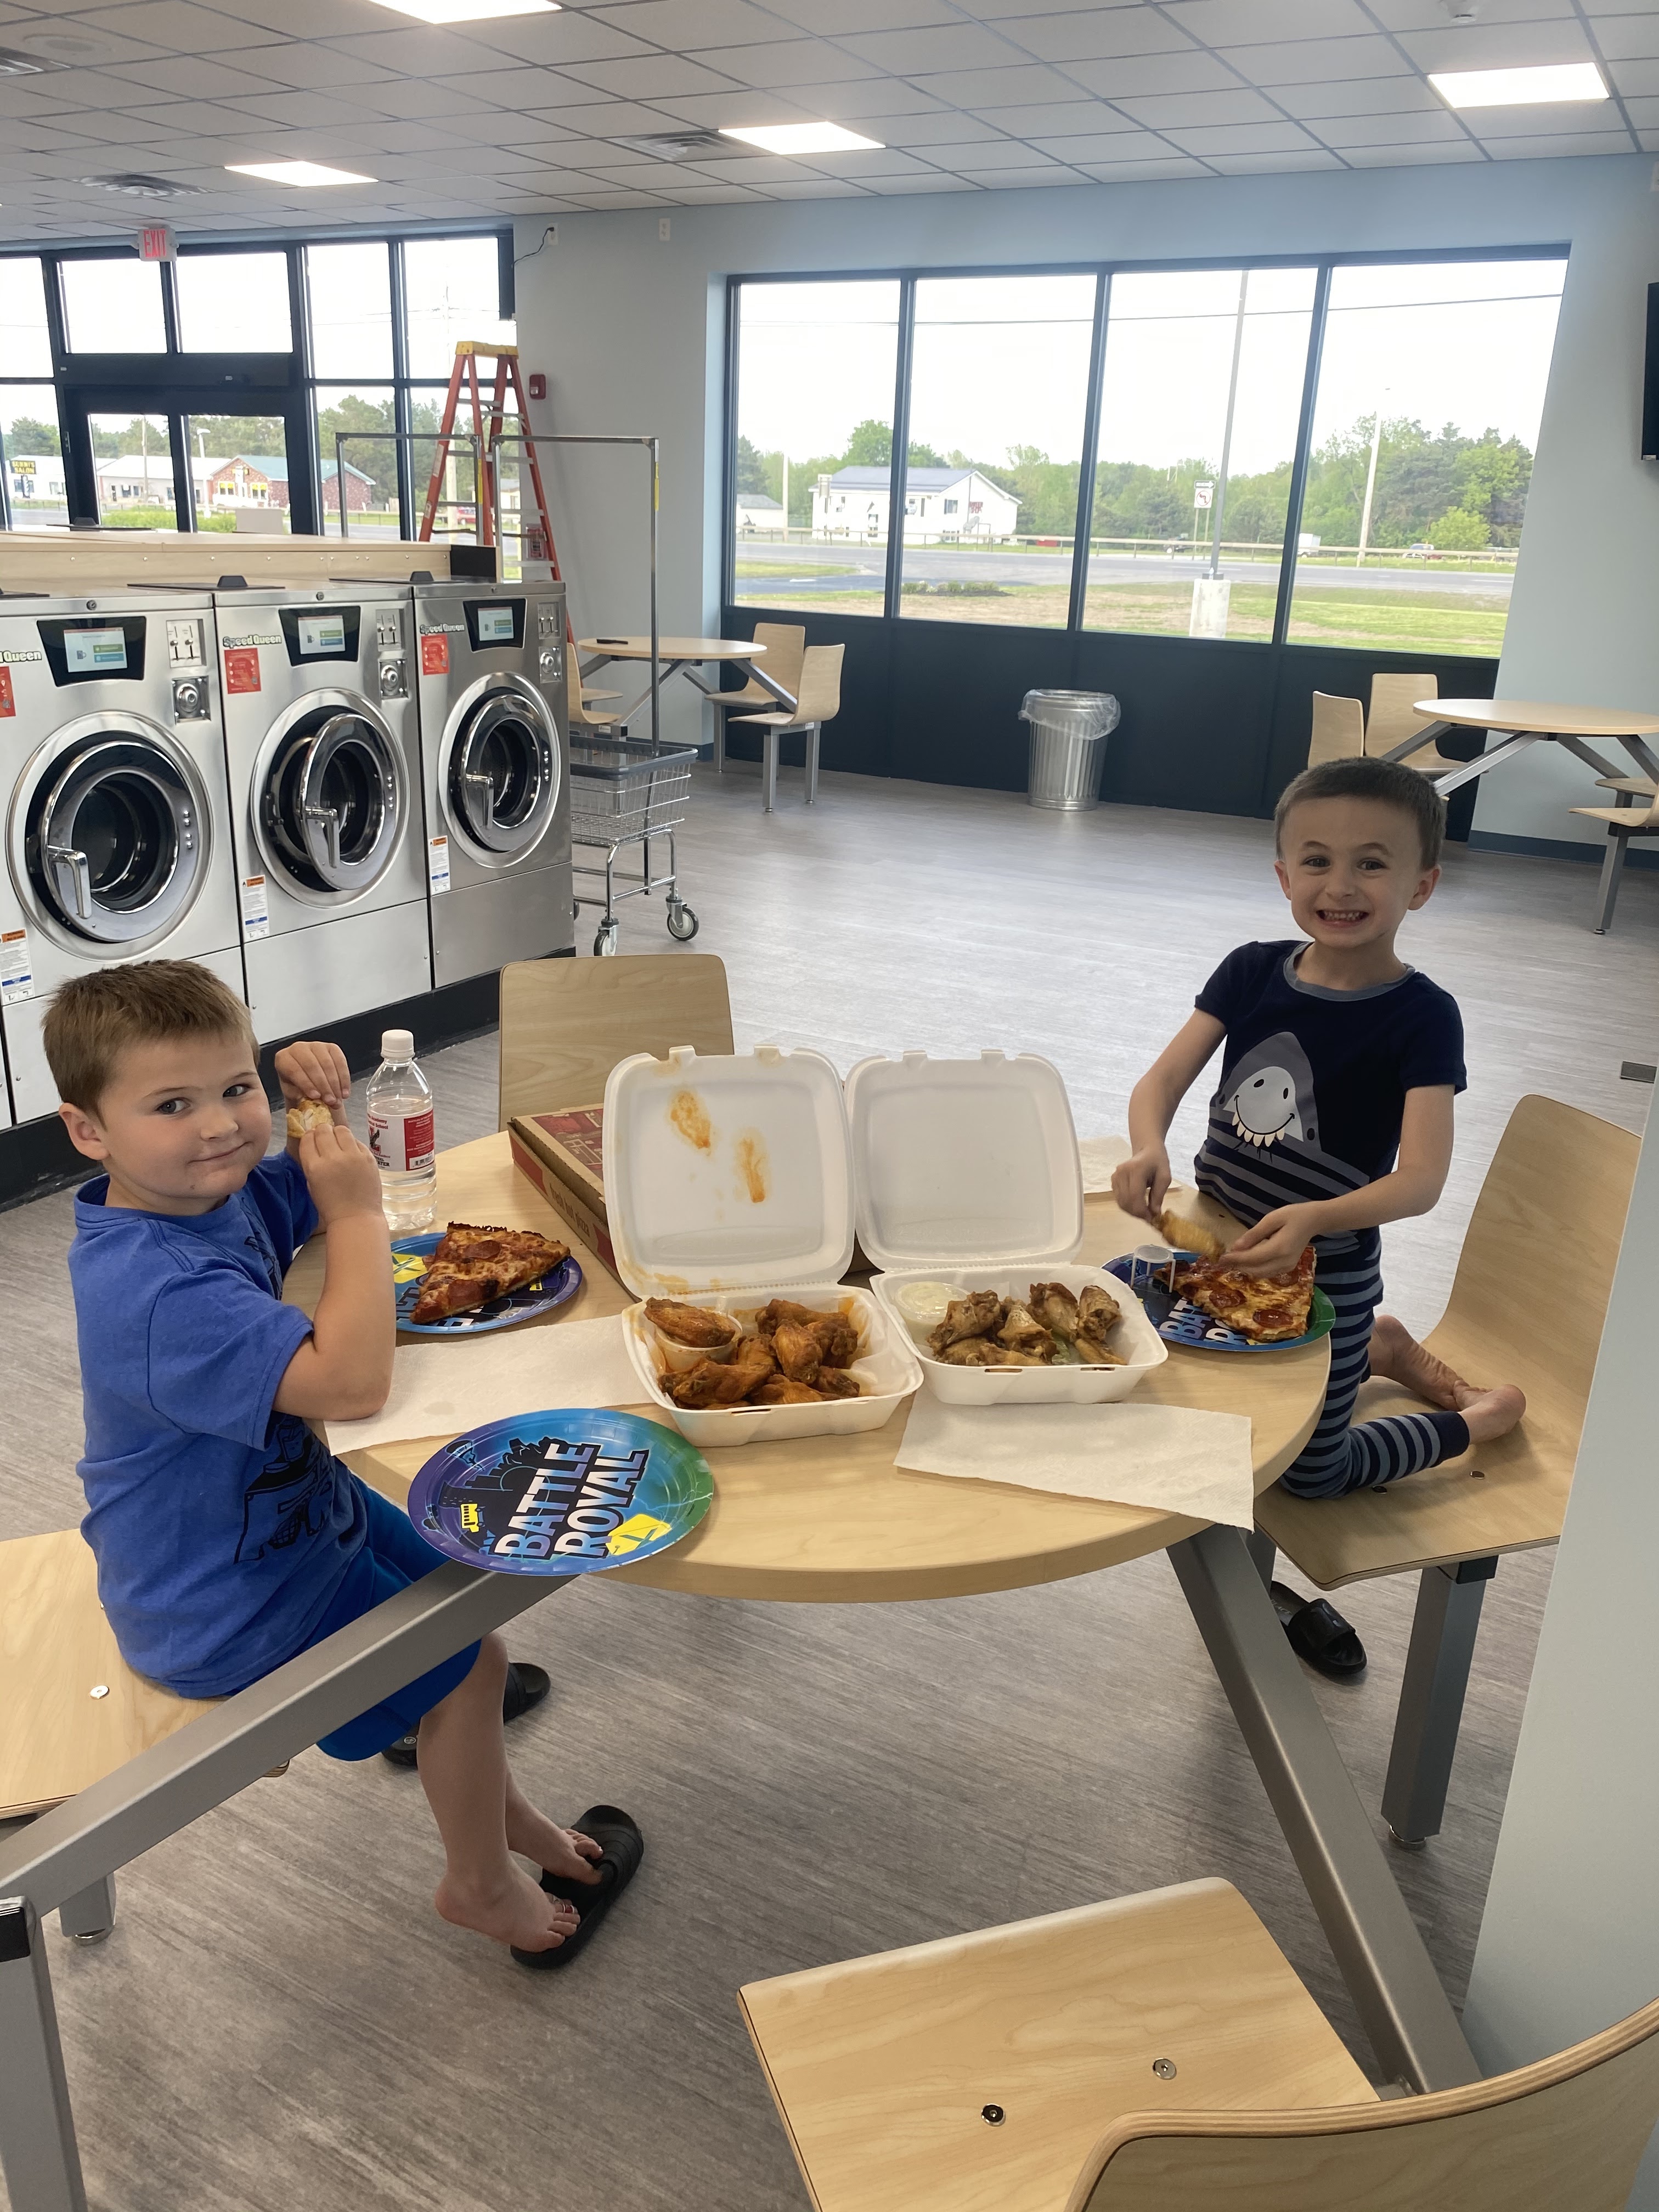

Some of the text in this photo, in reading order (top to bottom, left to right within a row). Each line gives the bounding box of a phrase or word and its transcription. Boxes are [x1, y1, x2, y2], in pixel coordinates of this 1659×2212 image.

[143, 229, 166, 257] EXIT
[420, 623, 465, 636] Speed Queen
[223, 634, 282, 648] Speed Queen
[3, 650, 42, 663] Queen
[494, 1443, 595, 1557] BATTLE
[554, 1453, 645, 1556] ROYAL
